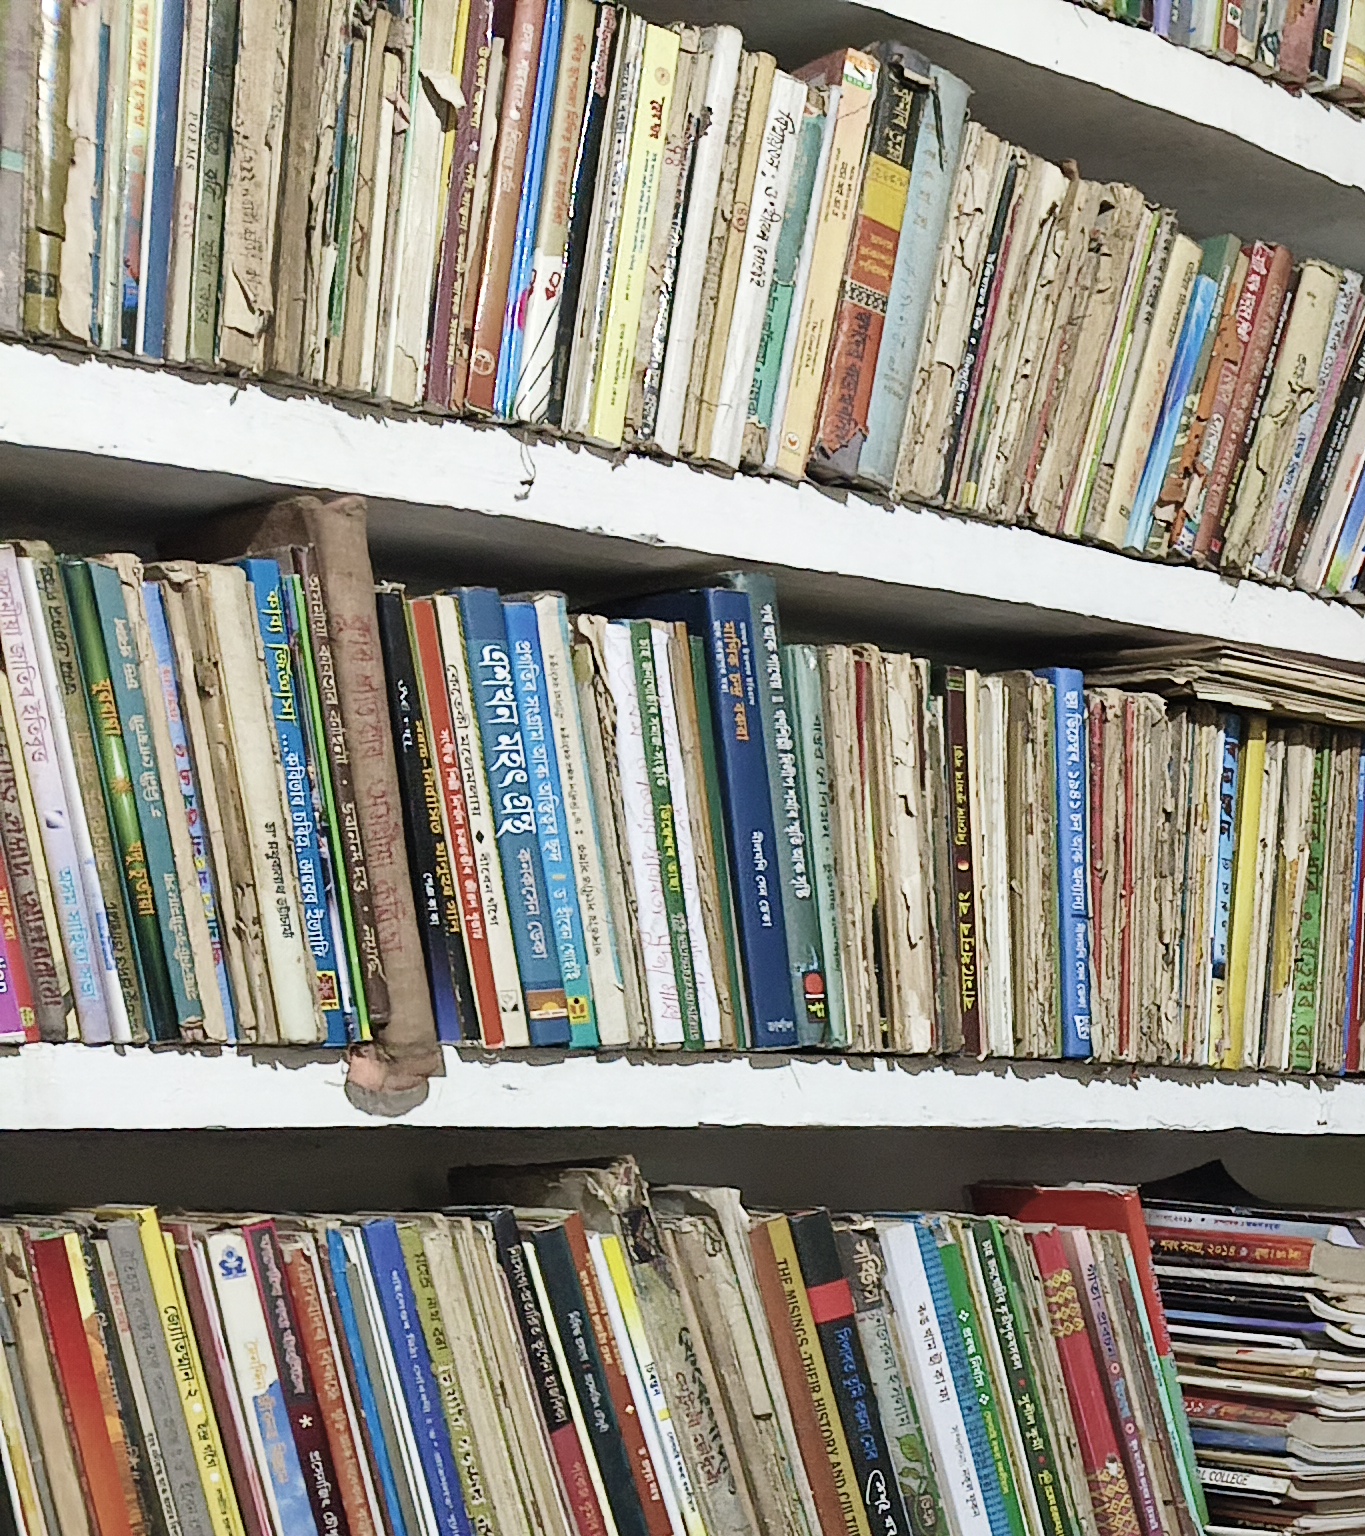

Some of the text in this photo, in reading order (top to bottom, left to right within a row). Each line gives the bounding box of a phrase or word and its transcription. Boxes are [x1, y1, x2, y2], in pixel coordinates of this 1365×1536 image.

[185, 111, 196, 171] POEMS
[477, 644, 521, 723] এশখন
[486, 731, 530, 787] মহৎ
[775, 1258, 794, 1286] THE
[783, 1289, 810, 1347] MISINGS
[811, 1398, 839, 1458] HISTORY
[827, 1461, 847, 1489] AND
[1207, 1470, 1248, 1486] COLLEGE
